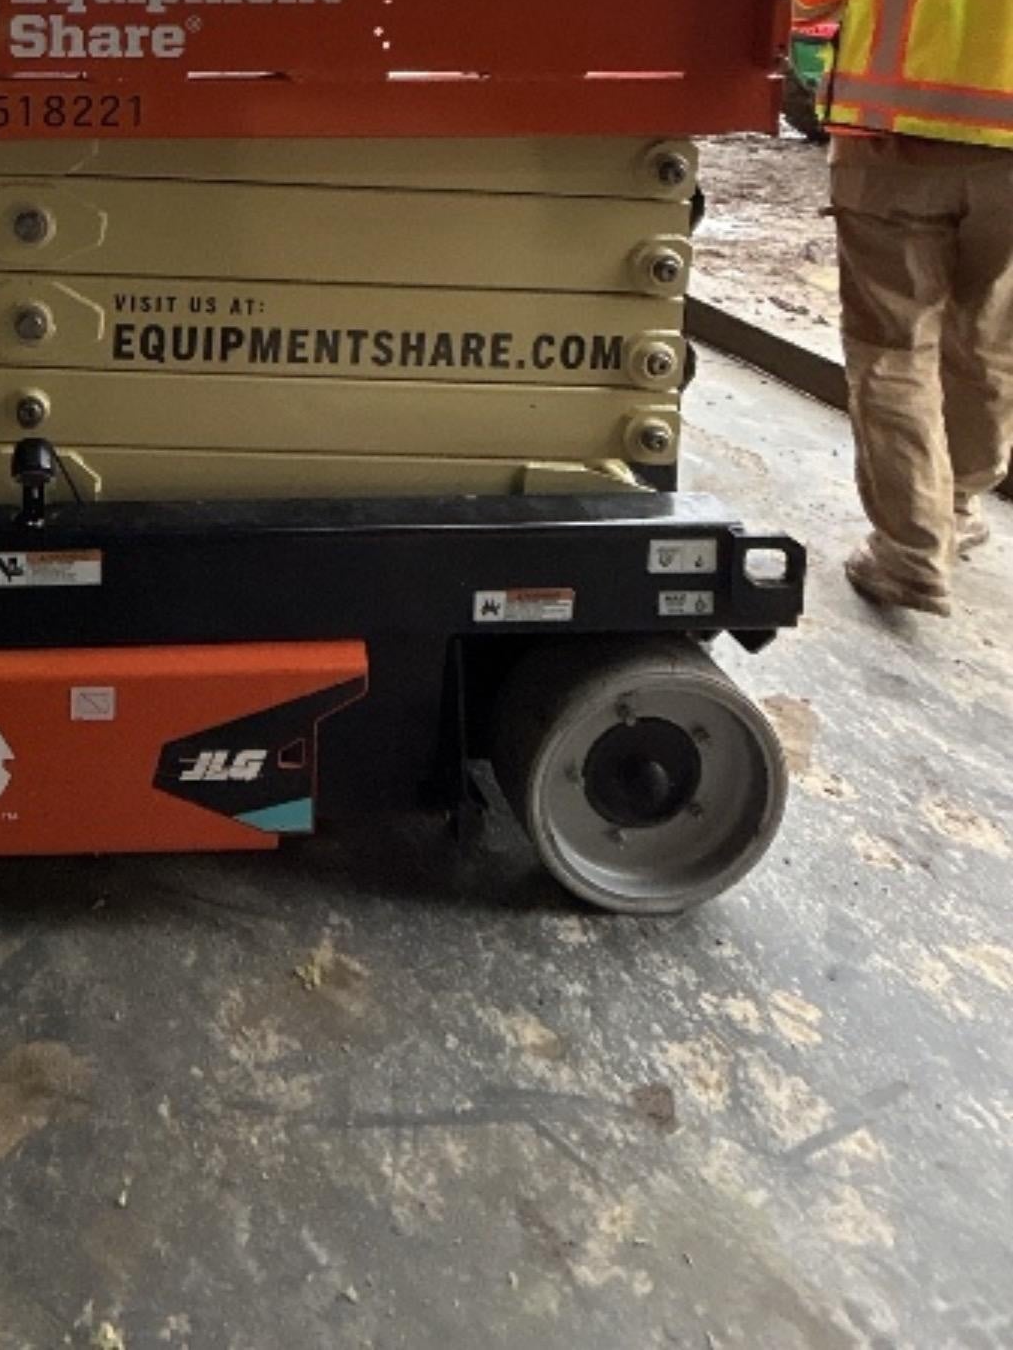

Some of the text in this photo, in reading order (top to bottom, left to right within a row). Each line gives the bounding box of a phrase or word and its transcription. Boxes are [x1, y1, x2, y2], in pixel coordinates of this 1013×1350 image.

[114, 293, 265, 317] VISIT US AT:
[112, 322, 624, 371] EQUIPMENTSHARE.COM
[178, 749, 267, 782] JLG
